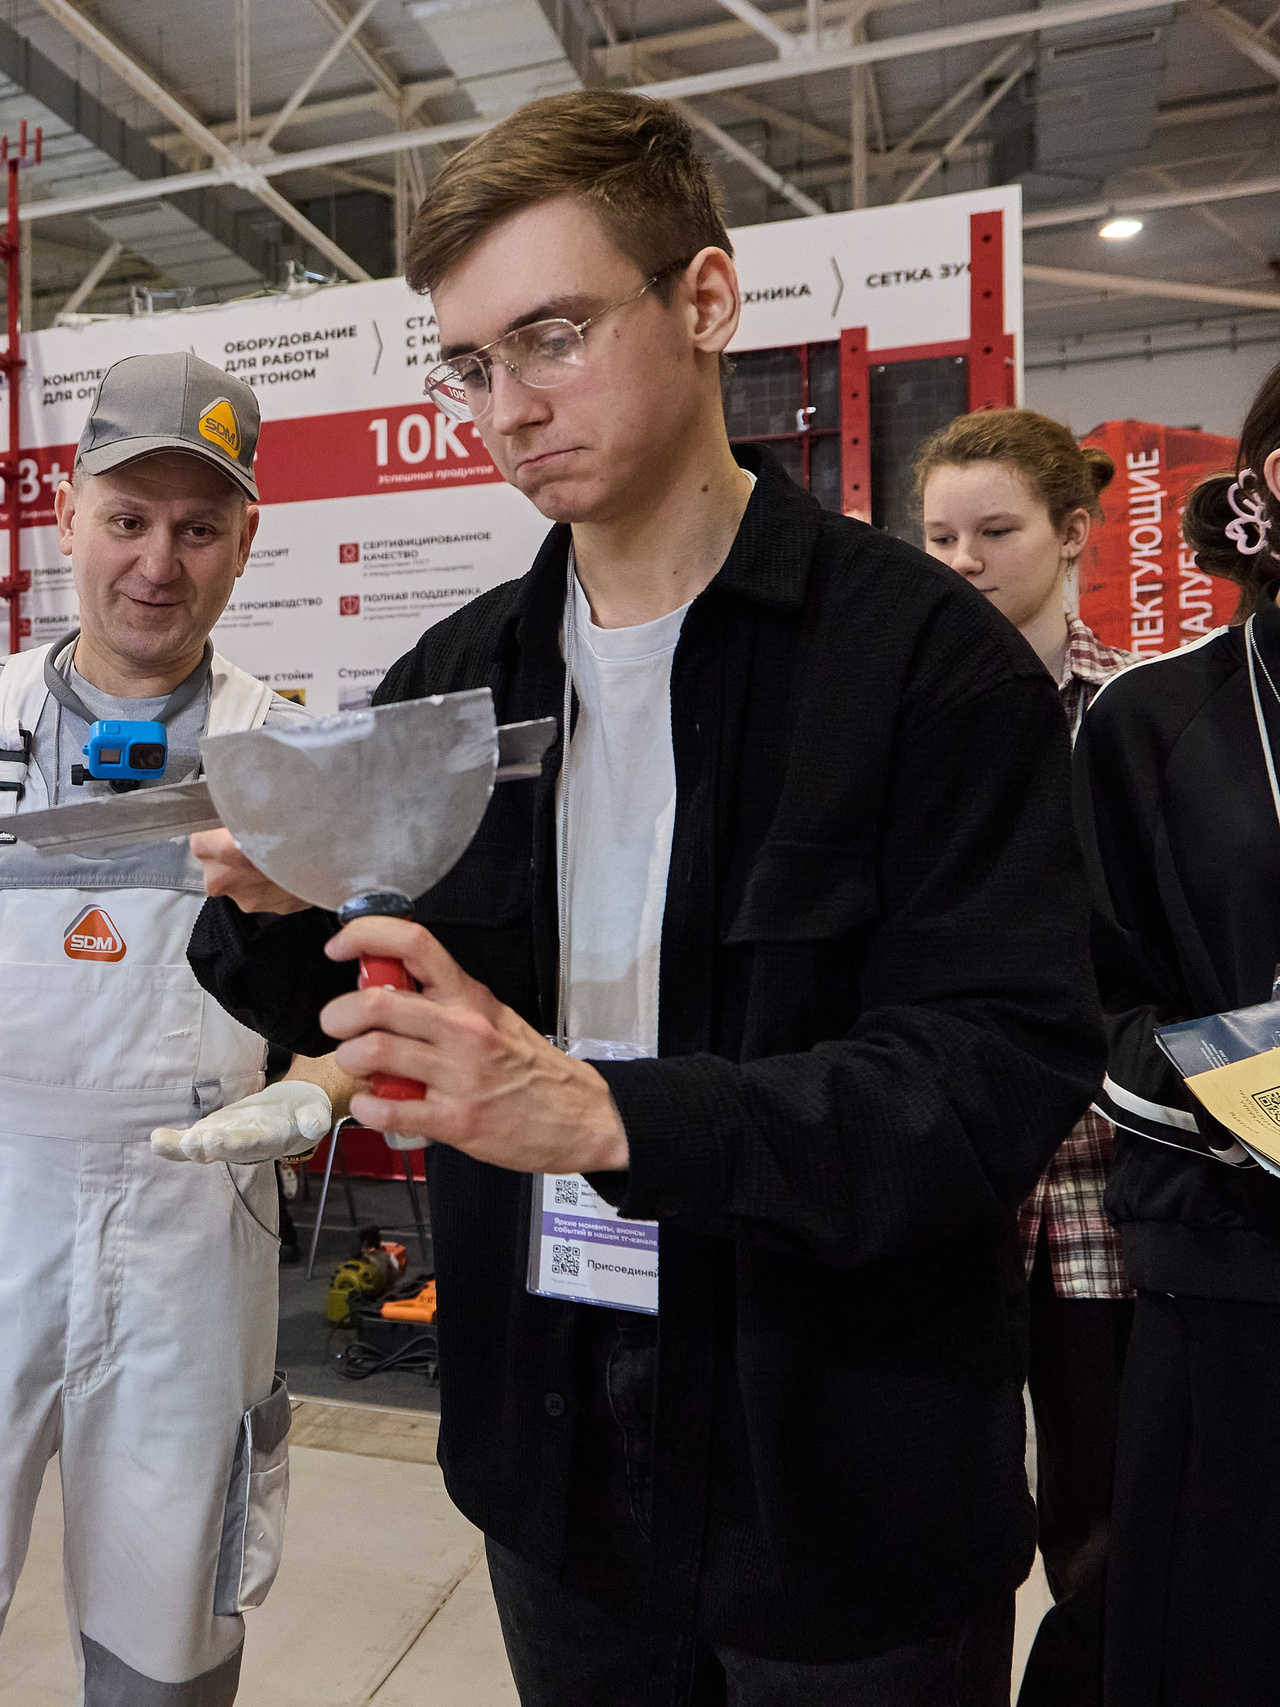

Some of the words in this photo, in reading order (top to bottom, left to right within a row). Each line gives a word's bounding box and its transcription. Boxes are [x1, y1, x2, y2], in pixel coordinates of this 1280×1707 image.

[865, 266, 933, 288] СЕТКА
[742, 284, 811, 303] ХНИКА
[406, 316, 437, 329] СТА
[224, 324, 358, 353] ОБОРУДОВАНИЕ
[225, 358, 257, 373] ДЛЯ
[262, 347, 330, 367] РАБОТЫ
[42, 368, 108, 386] КОМПЛЕ
[43, 391, 73, 406] ДЛЯ
[77, 386, 97, 399] ОП
[205, 417, 235, 445] SDM
[369, 411, 487, 466] 10K
[363, 531, 491, 550] СЕРТИФИЦИРОВАННОЕ
[250, 548, 289, 559] КСПОРТ
[363, 549, 419, 562] КАЧЕСТВО
[240, 597, 323, 611] ПРОИЗВОДСТВО
[363, 591, 408, 603] ПОЛНАЯ
[411, 587, 482, 600] ПОДДЕРЖКА
[274, 670, 314, 681] стойки
[70, 934, 113, 950] SDM
[554, 1217, 577, 1227] Яркие
[578, 1222, 615, 1233] моменты,
[616, 1228, 645, 1237] анонсы
[554, 1225, 587, 1237] событий
[594, 1233, 620, 1241] нашем
[587, 1259, 658, 1278] Присоединяй
